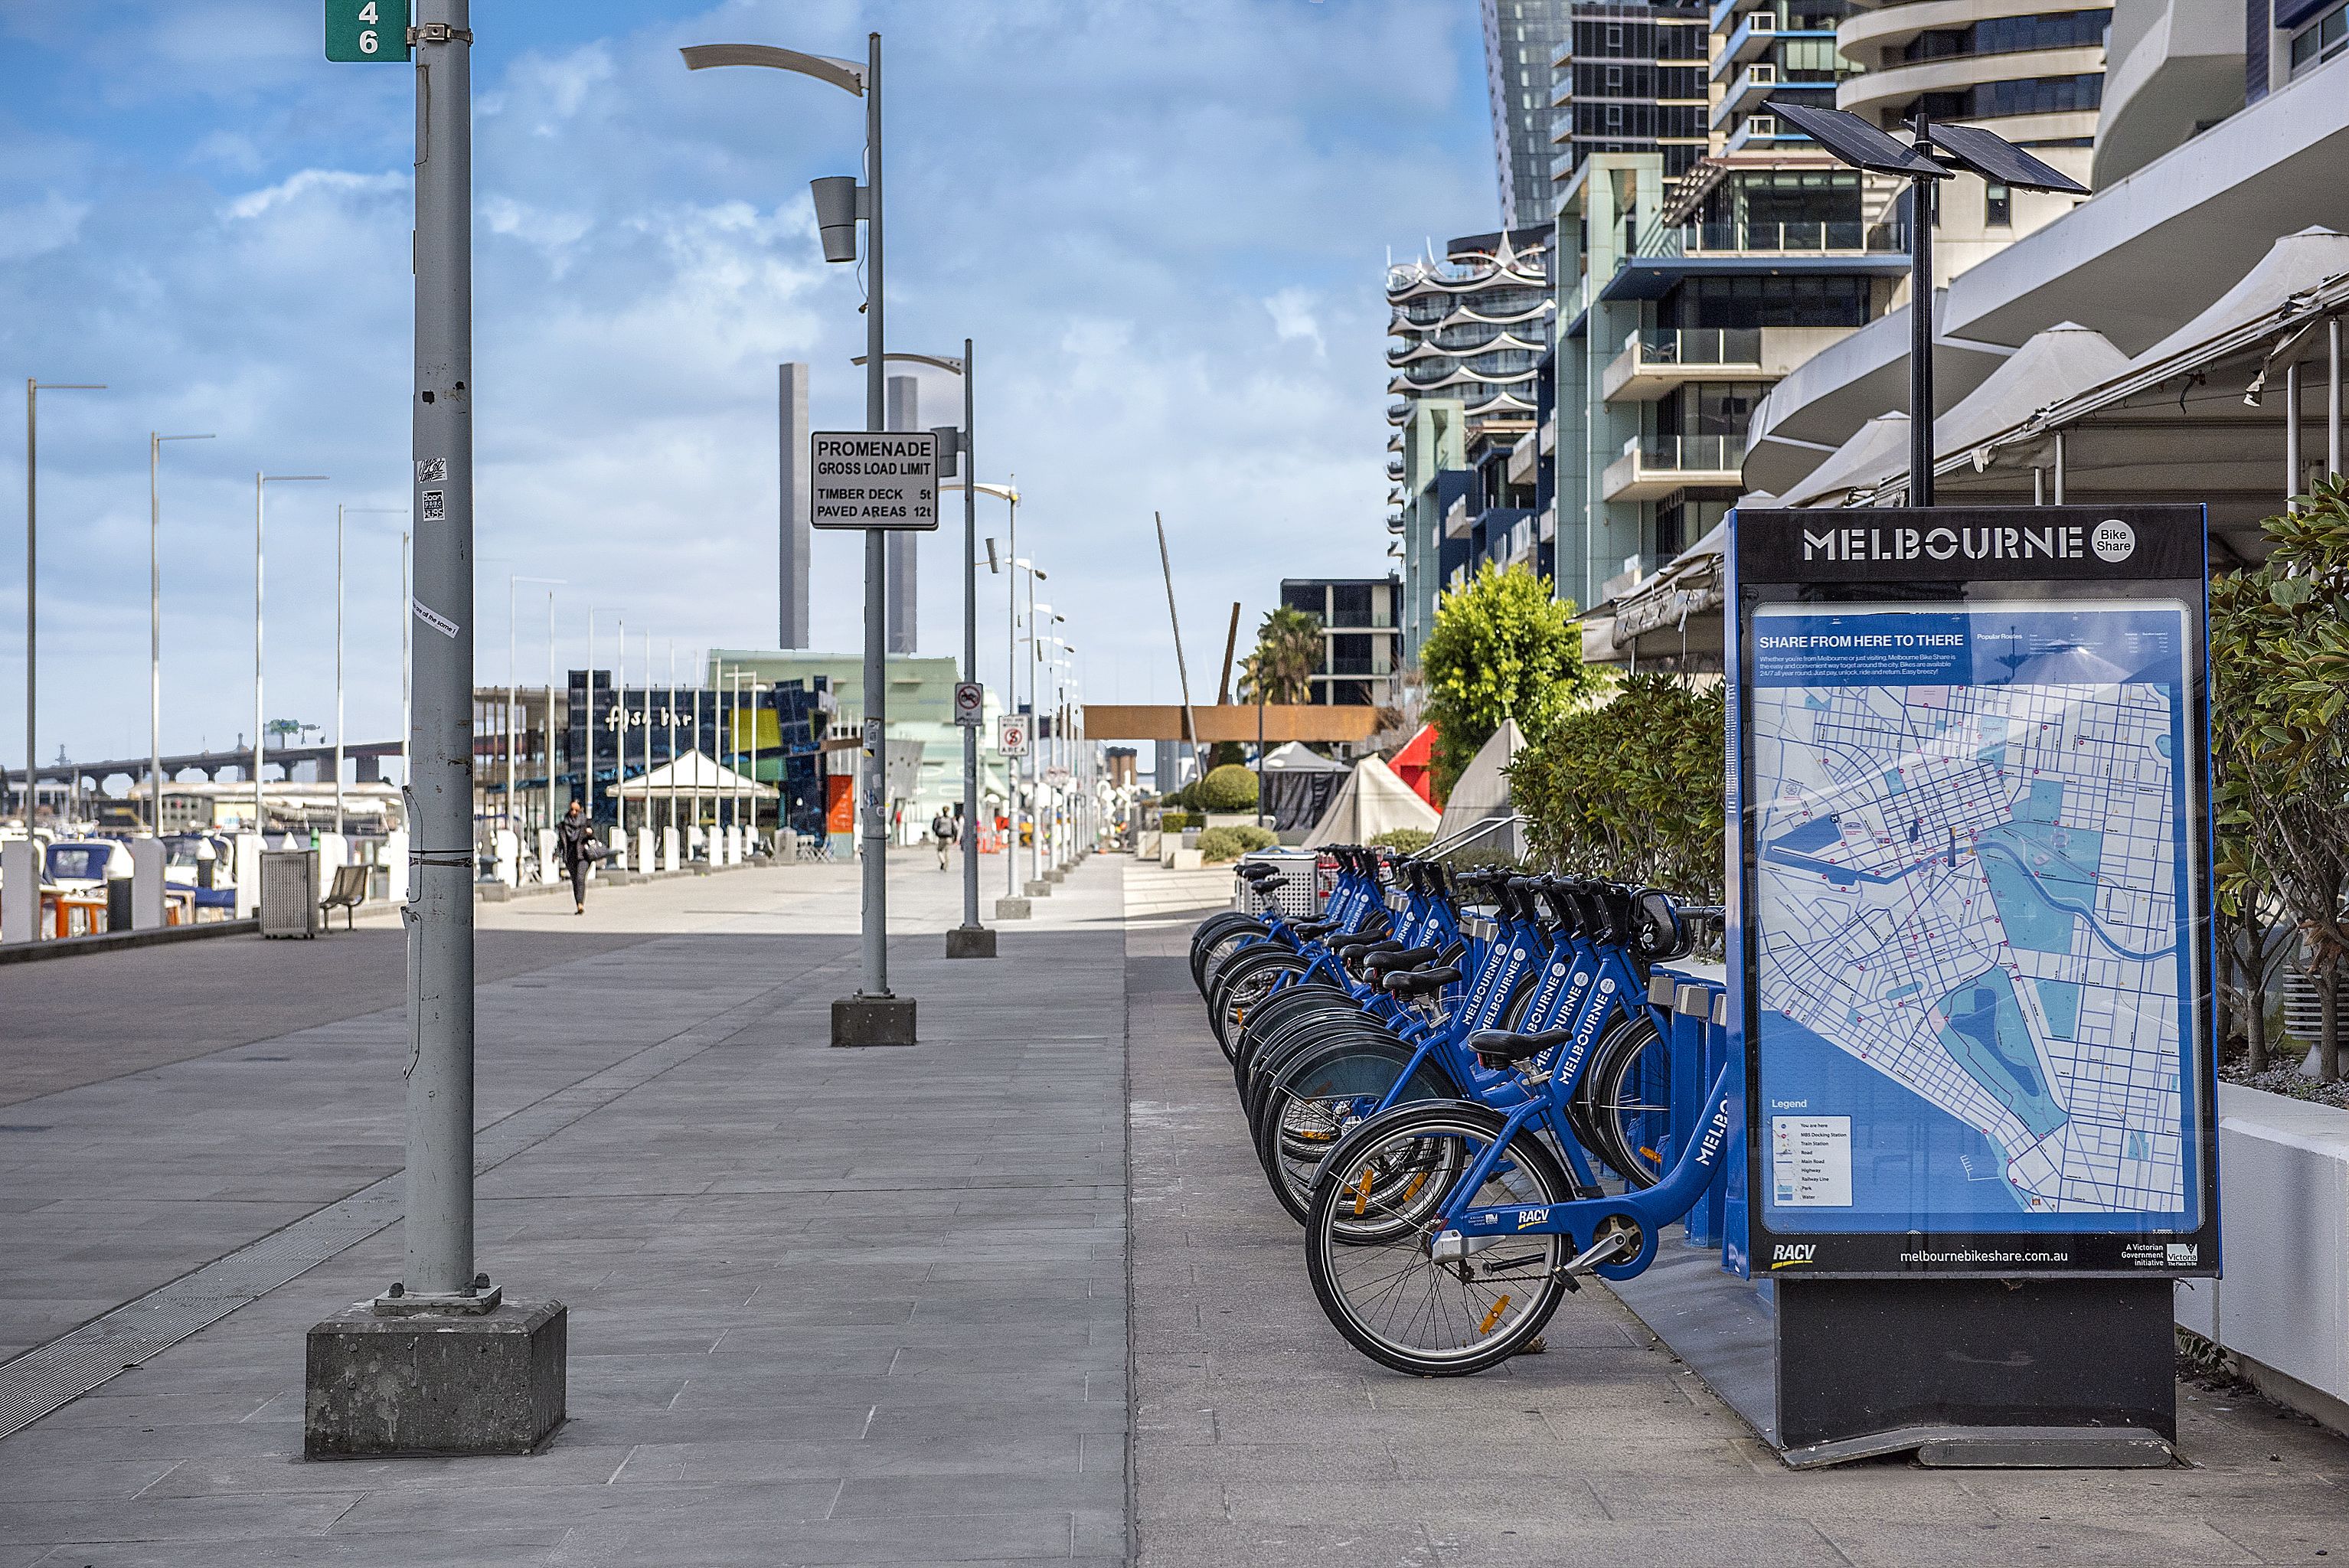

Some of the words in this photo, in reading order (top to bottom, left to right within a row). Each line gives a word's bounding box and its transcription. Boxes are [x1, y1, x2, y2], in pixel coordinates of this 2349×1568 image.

[358, 1, 379, 24] 4
[359, 30, 378, 54] 6
[818, 441, 931, 456] PROMENADE
[818, 462, 861, 475] GROSS
[864, 462, 897, 475] LOAD
[900, 462, 931, 475] LIMIT
[818, 488, 864, 499] TIMBER
[869, 488, 903, 499] DECK
[920, 489, 931, 500] 5t
[817, 506, 858, 517] PAVED
[861, 506, 907, 517] AREAS
[913, 506, 931, 517] 12t
[2101, 529, 2127, 540] Bike
[1804, 527, 2083, 560] MELBOURNE
[2096, 541, 2131, 551] Share
[1759, 636, 1808, 648] SHARE
[1810, 635, 1851, 648] FROM
[1854, 635, 1892, 647] HERE
[1894, 635, 1914, 647] TO
[1916, 634, 1964, 646] THERE
[1462, 955, 1502, 1025] MELBOURNE
[1482, 959, 1521, 1030] MELBOURNE
[1524, 975, 1560, 1034] BOURNE
[1558, 992, 1609, 1085] MELBOURNE
[1772, 1099, 1808, 1109] Legend
[1518, 1208, 1550, 1223] RACV
[1772, 1244, 1817, 1261] RACV
[1900, 1250, 2068, 1263] melbournebikeshare.com.au
